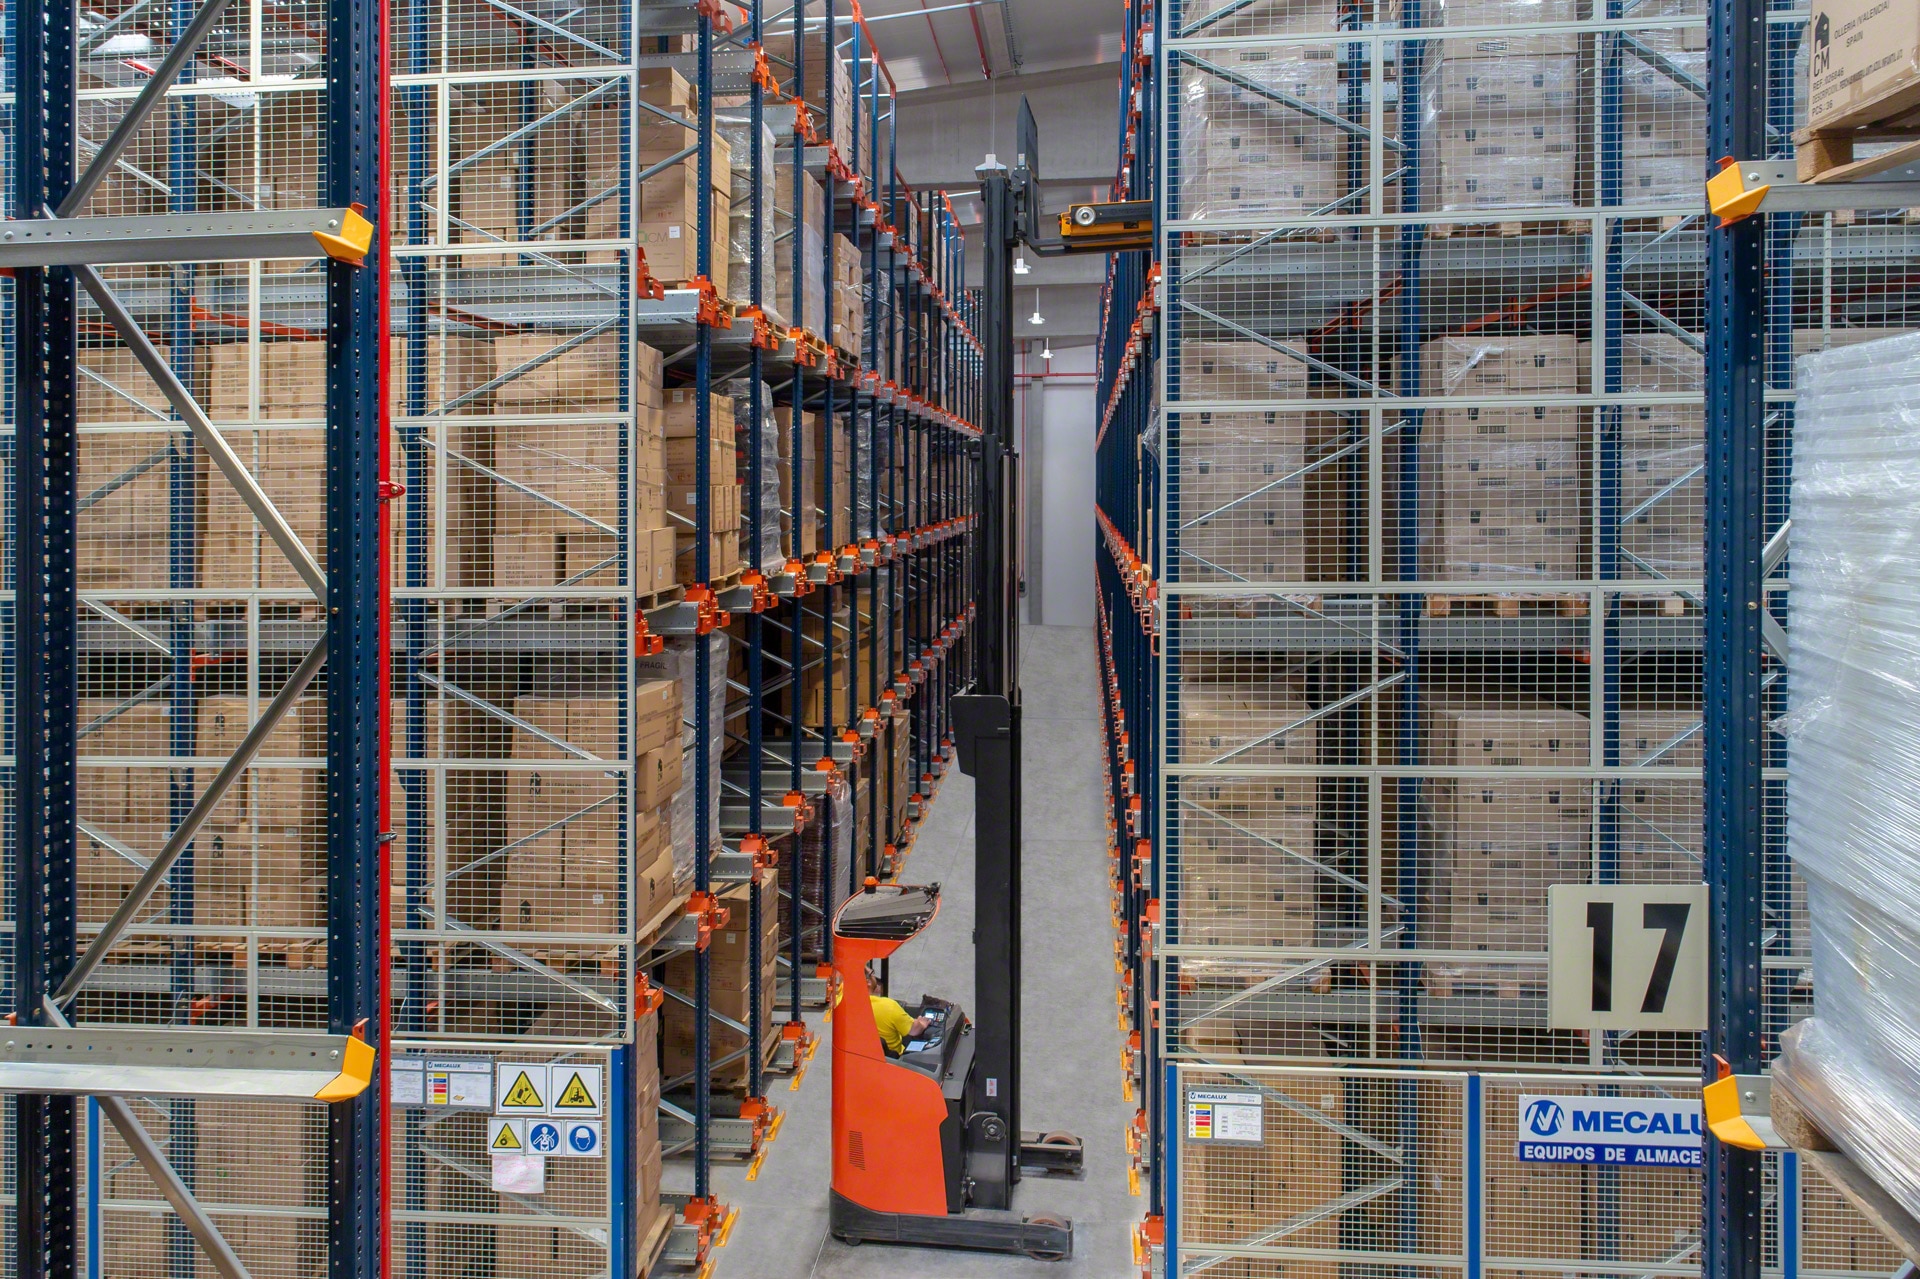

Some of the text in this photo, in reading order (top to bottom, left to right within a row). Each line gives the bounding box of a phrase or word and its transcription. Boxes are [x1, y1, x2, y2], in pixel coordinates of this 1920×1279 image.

[1846, 30, 1864, 48] SPAIN
[1813, 46, 1830, 78] CM
[1586, 903, 1691, 1013] 17
[1524, 1145, 1596, 1161] EQUIPOS
[1604, 1147, 1626, 1162] DE
